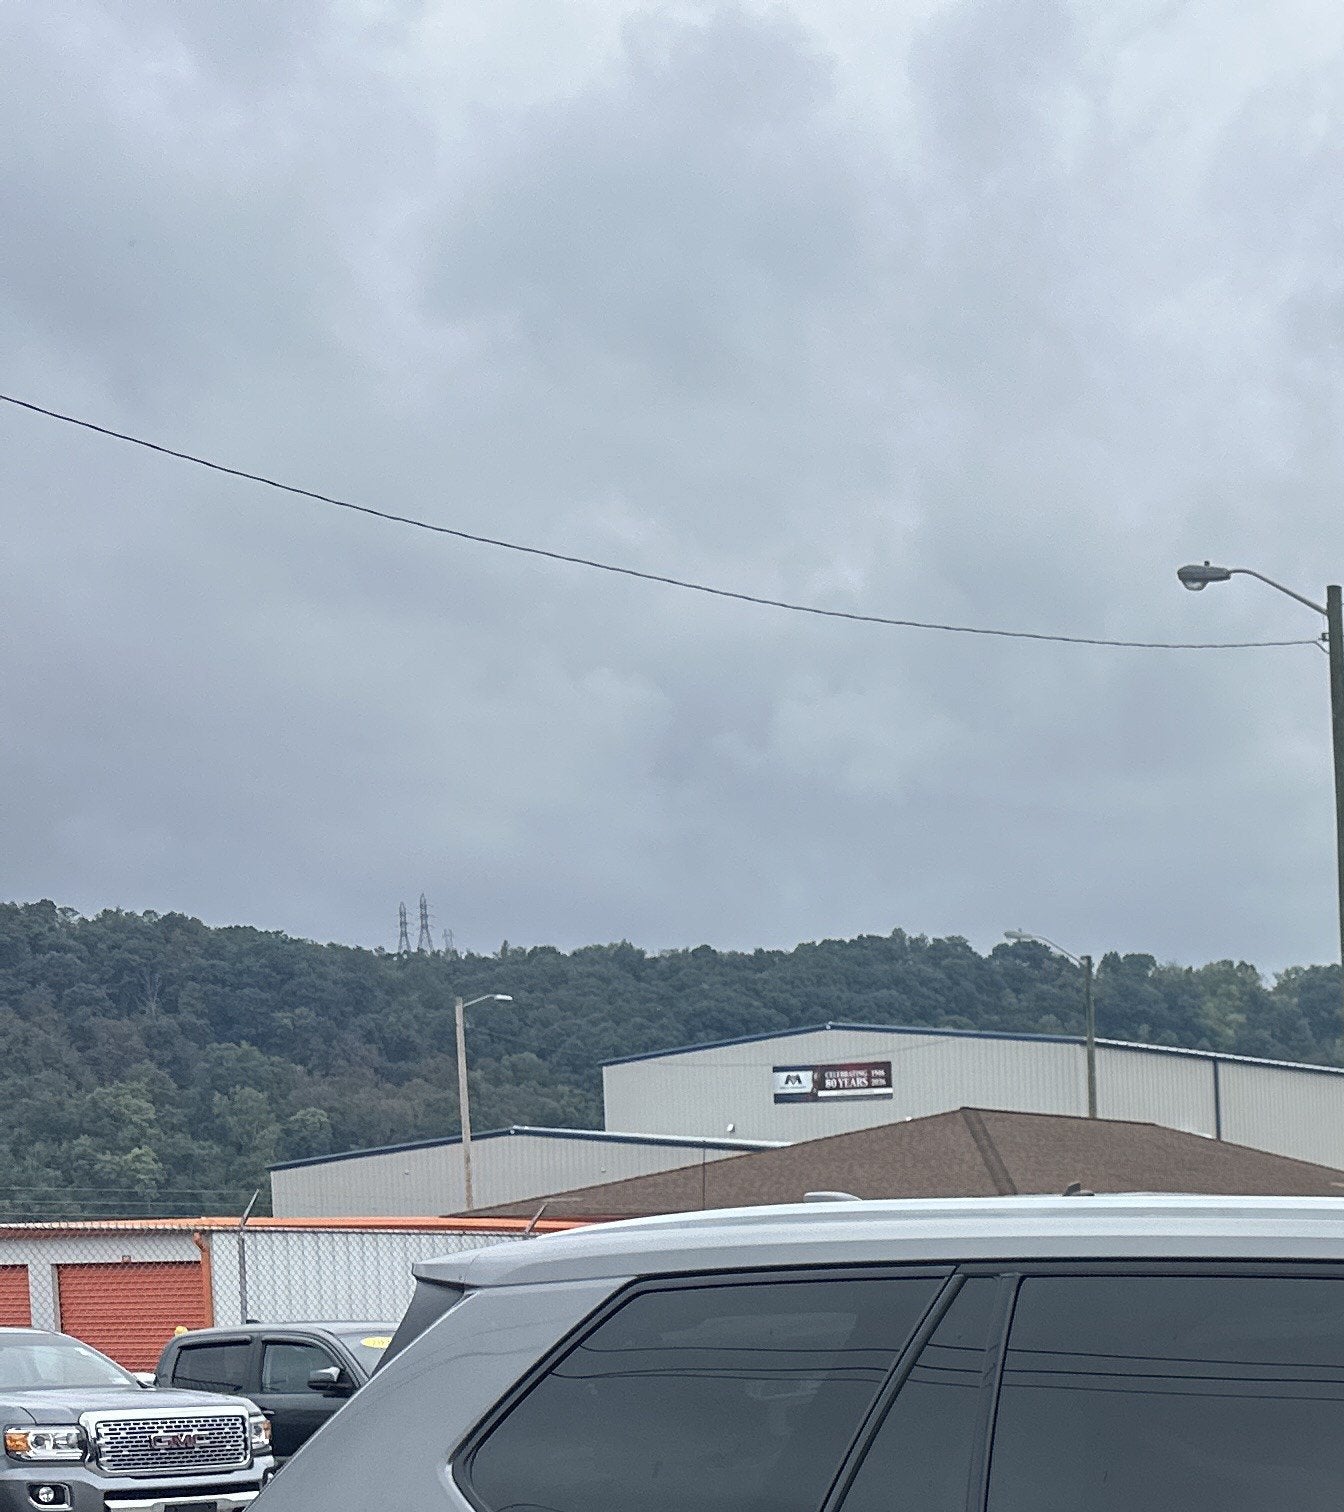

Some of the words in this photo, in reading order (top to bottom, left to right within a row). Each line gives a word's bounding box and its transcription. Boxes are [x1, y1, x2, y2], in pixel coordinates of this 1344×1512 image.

[824, 1078, 837, 1089] 80
[838, 1076, 869, 1089] YEARS
[149, 1432, 210, 1450] GMC
